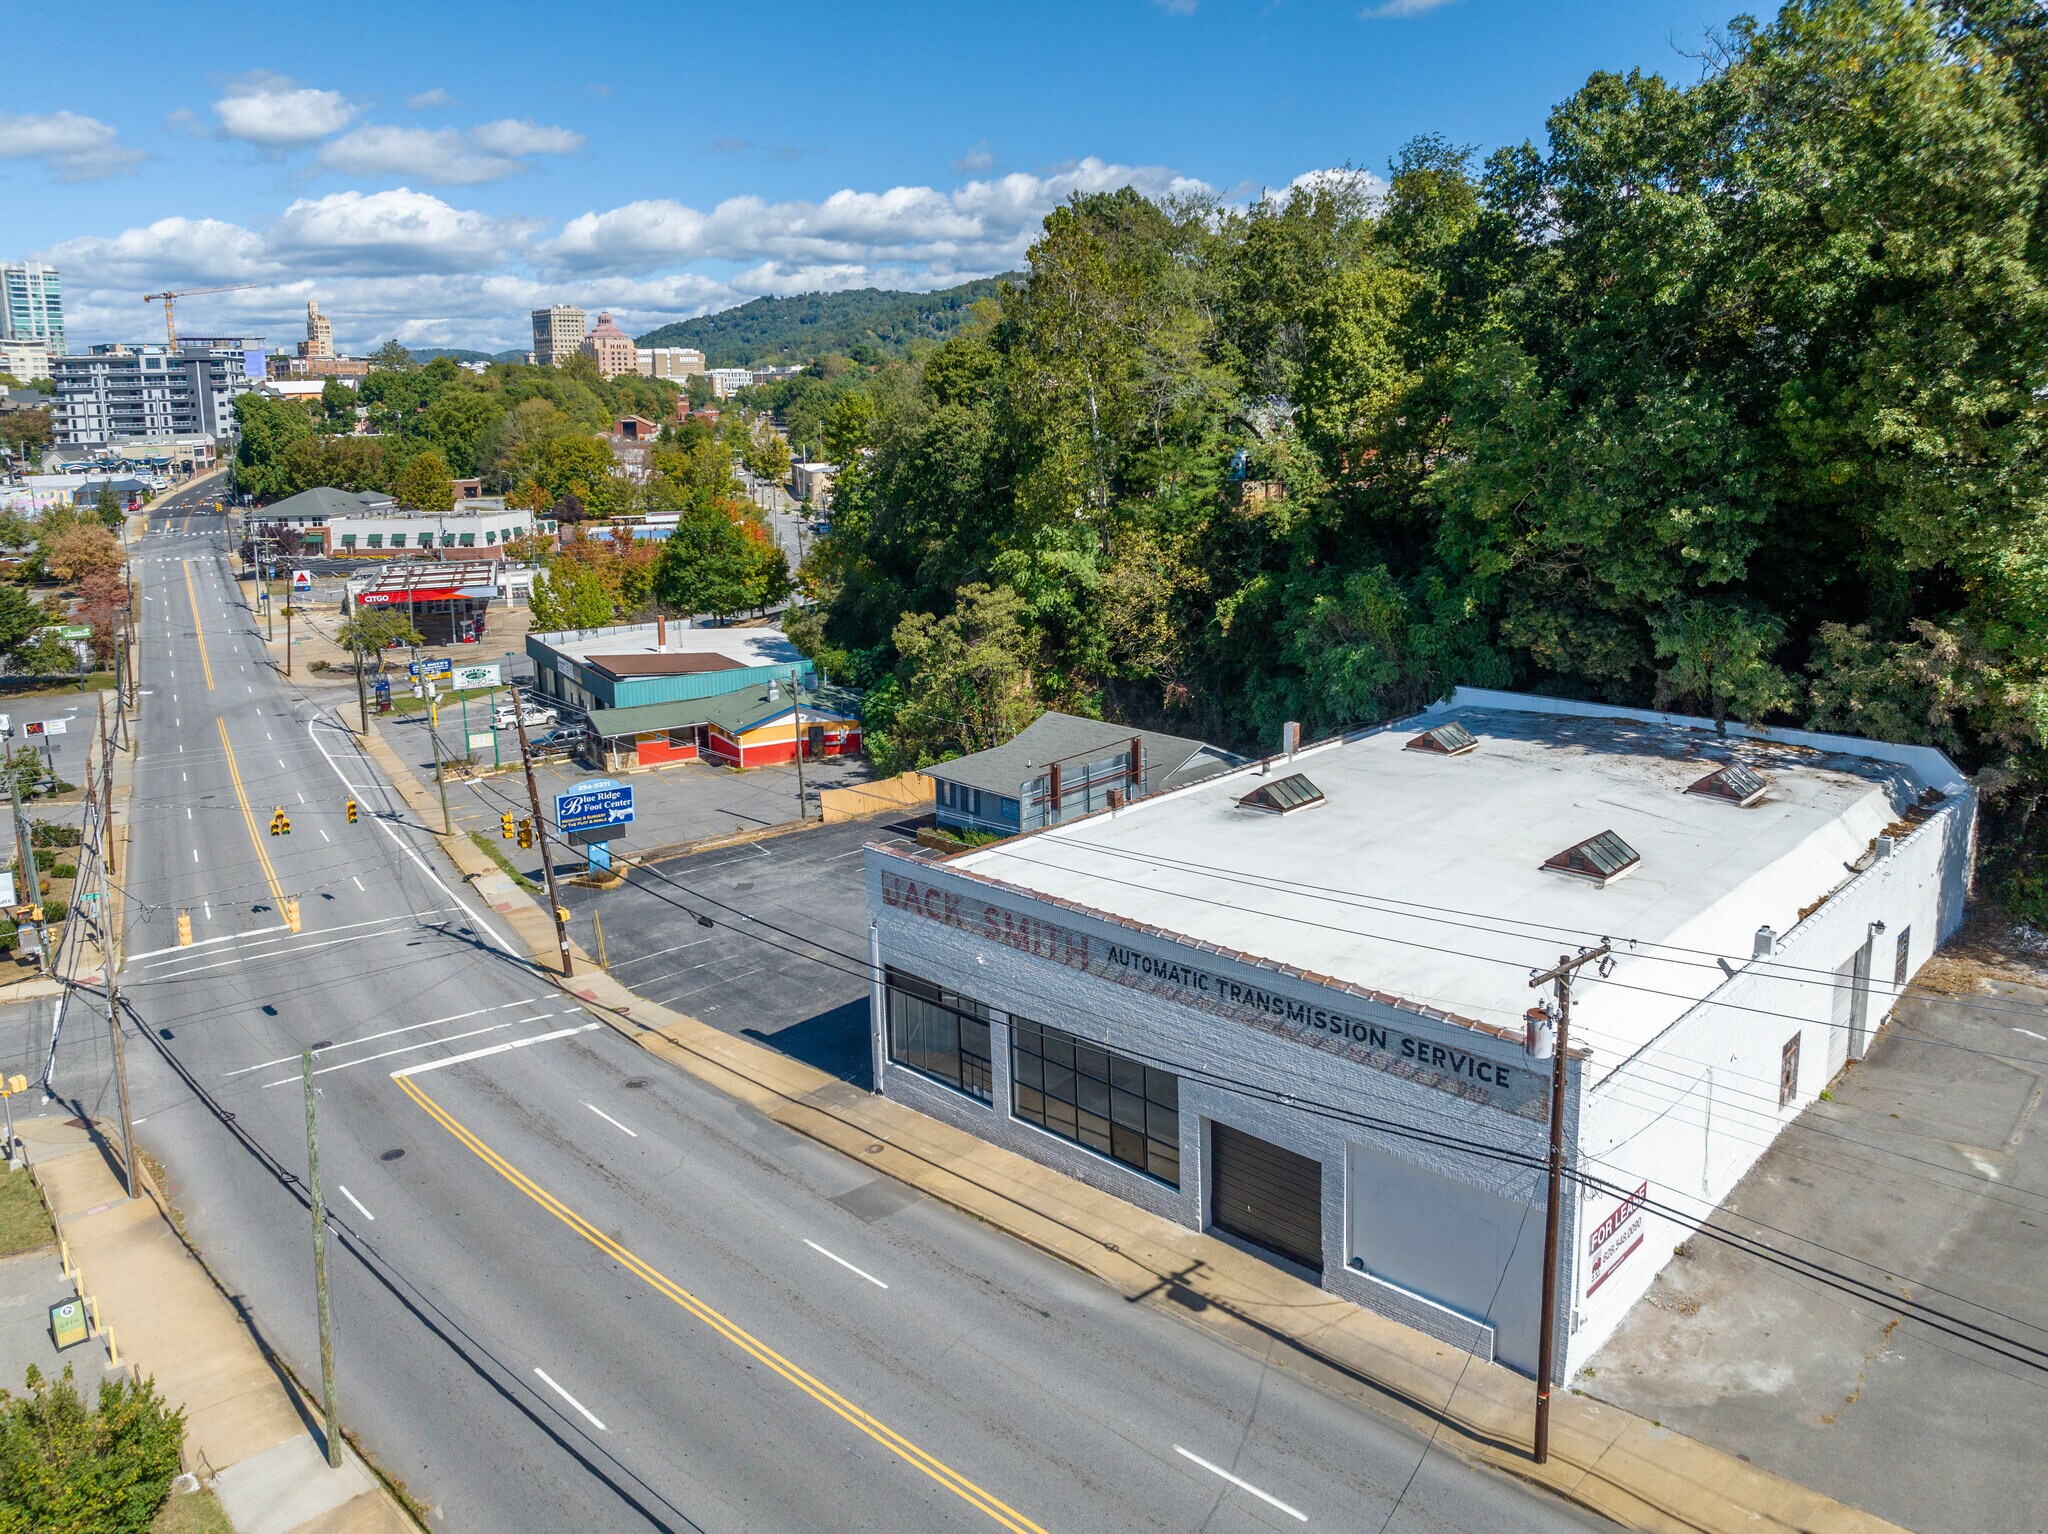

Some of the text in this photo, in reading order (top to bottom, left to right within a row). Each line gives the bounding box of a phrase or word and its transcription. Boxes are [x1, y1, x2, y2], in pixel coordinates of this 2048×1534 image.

[364, 595, 389, 603] CITGO
[578, 782, 610, 790] 254-5371
[561, 796, 596, 816] Blue
[584, 800, 632, 812] Foot Center
[884, 877, 1090, 972] JACK SMITH
[1107, 946, 1510, 1089] AUTOMATIC TRANSMISSION SERVICE
[1591, 1218, 1613, 1252] FOR
[60, 1318, 80, 1329] OPEN
